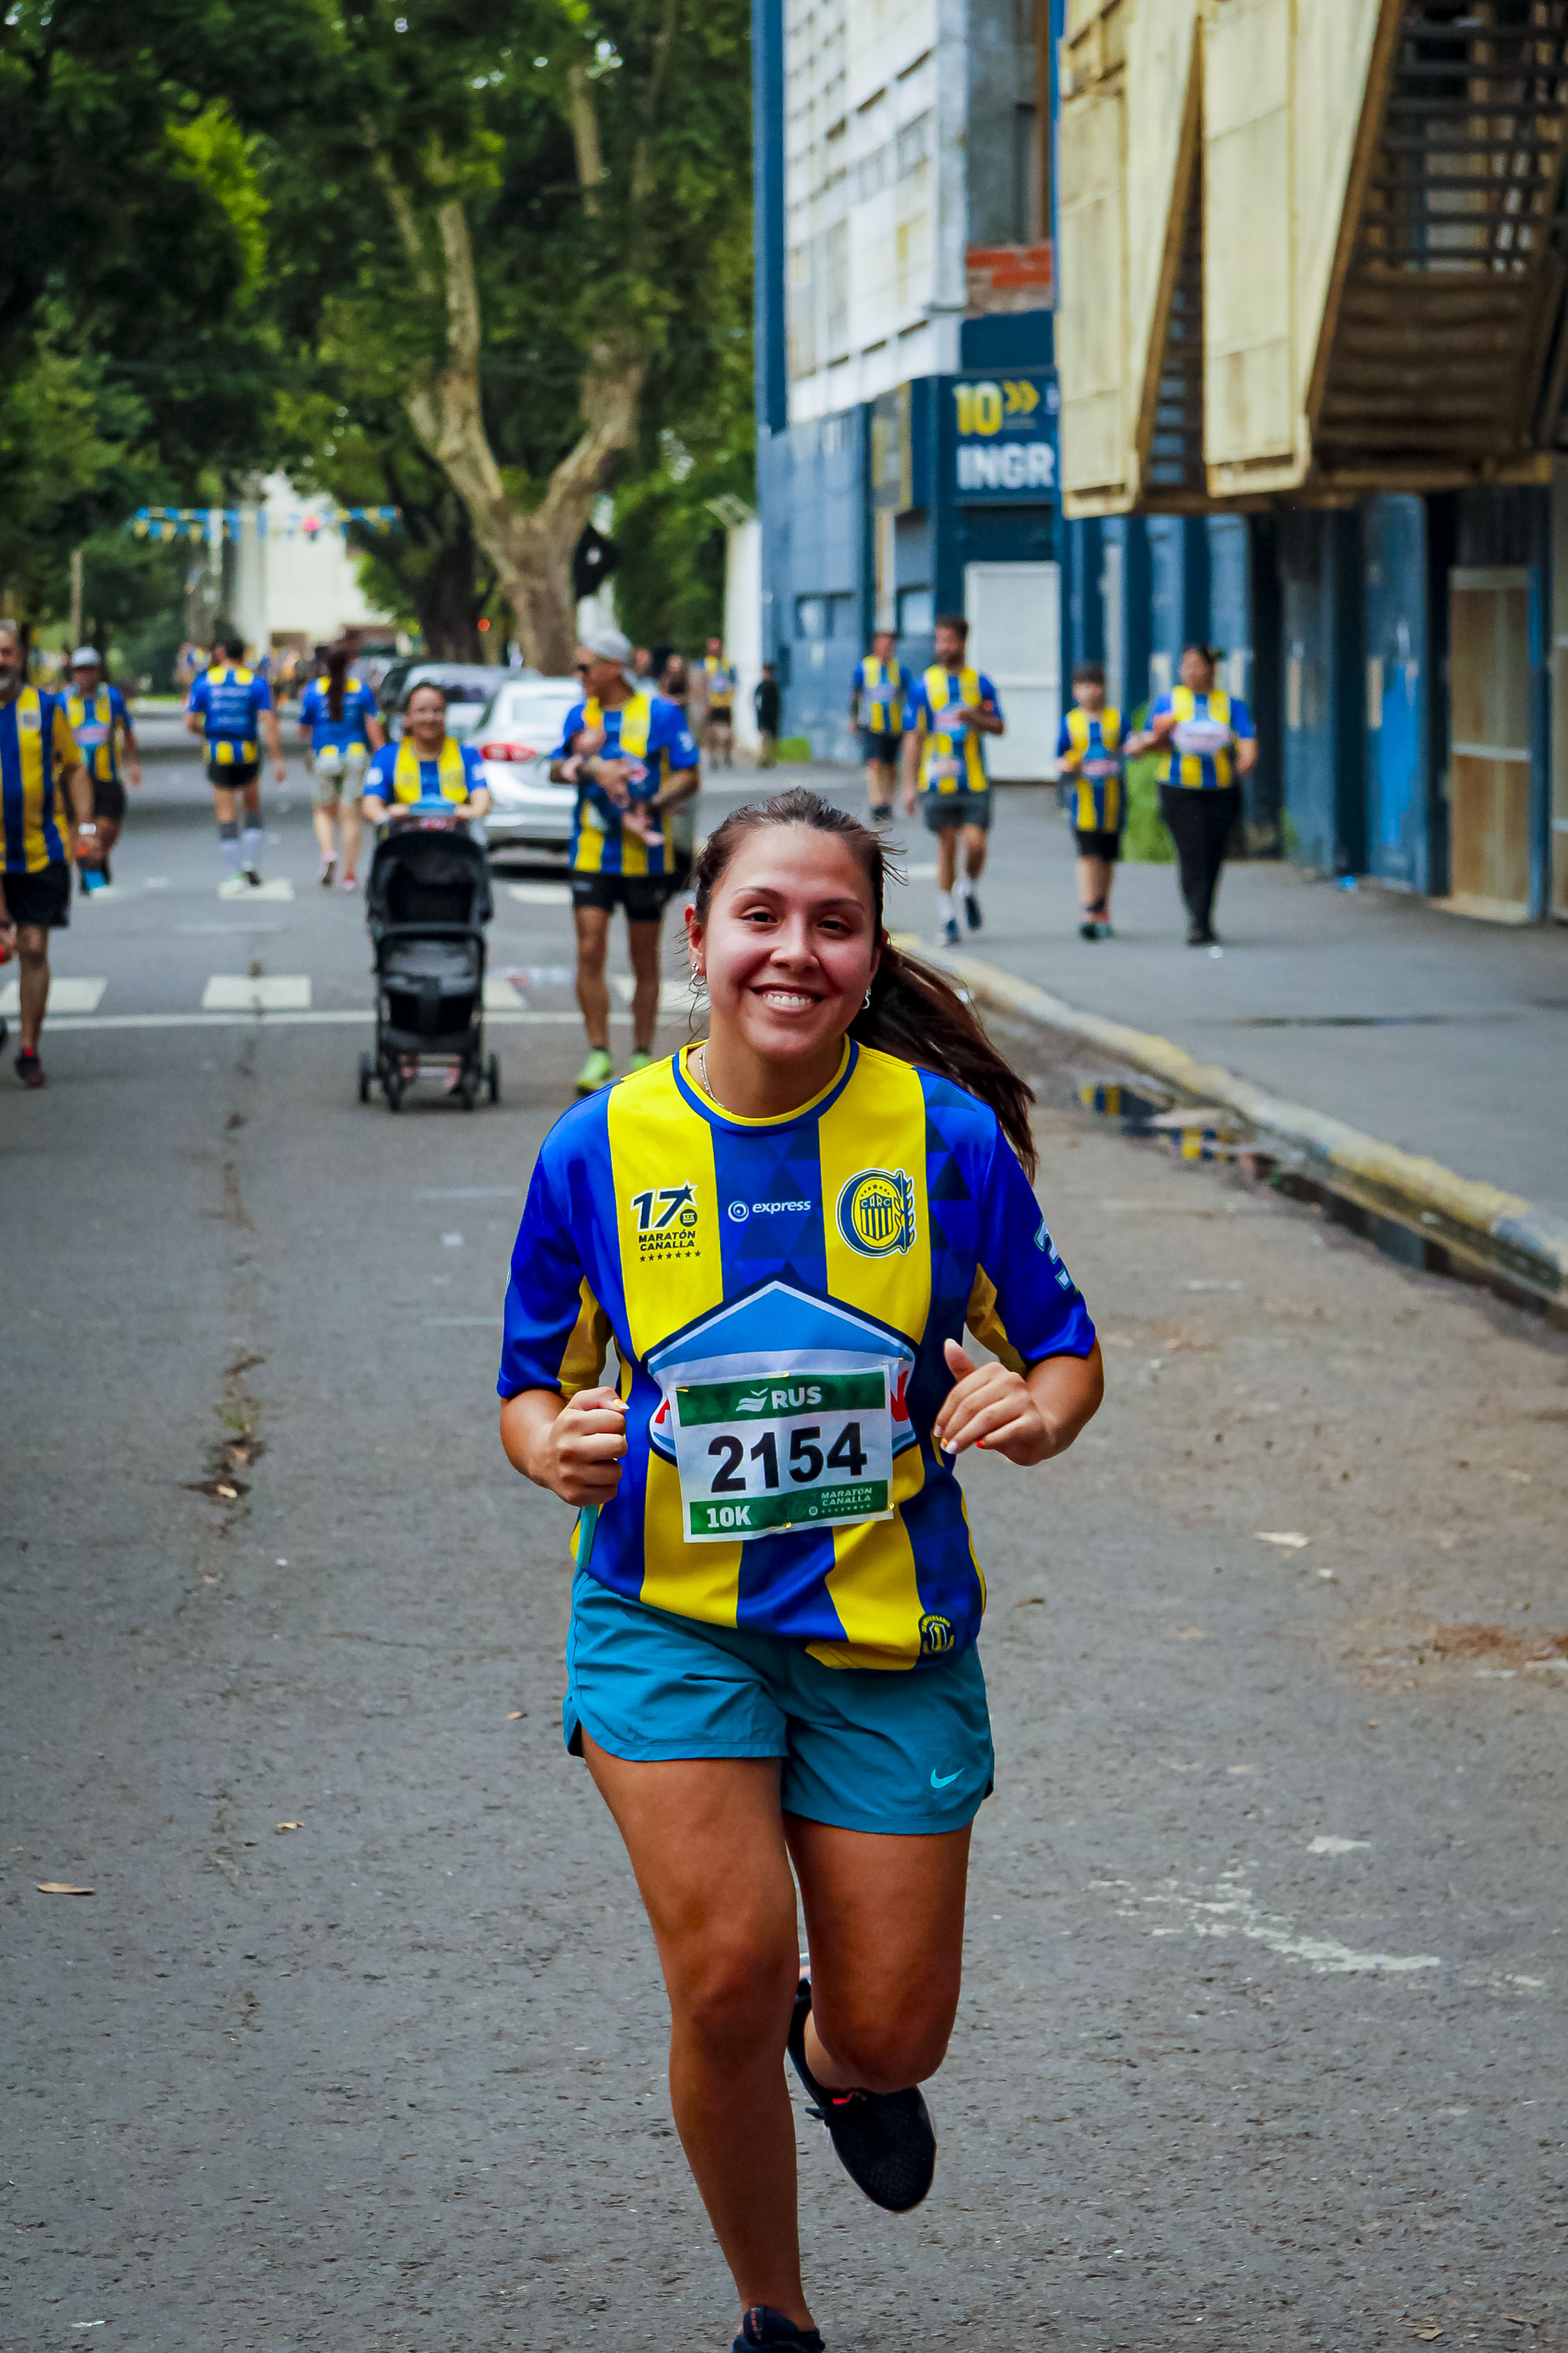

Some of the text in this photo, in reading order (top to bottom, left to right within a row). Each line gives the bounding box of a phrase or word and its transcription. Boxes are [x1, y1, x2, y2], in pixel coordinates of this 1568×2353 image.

[952, 382, 1002, 436] 10
[631, 1181, 696, 1232] 17
[752, 1201, 811, 1214] express
[861, 1194, 891, 1208] CARC
[639, 1229, 695, 1243] MARATÓN
[640, 1240, 695, 1252] CANALLA
[772, 1386, 822, 1409] RUS
[708, 1422, 868, 1493] 2154
[822, 1495, 871, 1507] CANALLA
[707, 1505, 752, 1528] 10K
